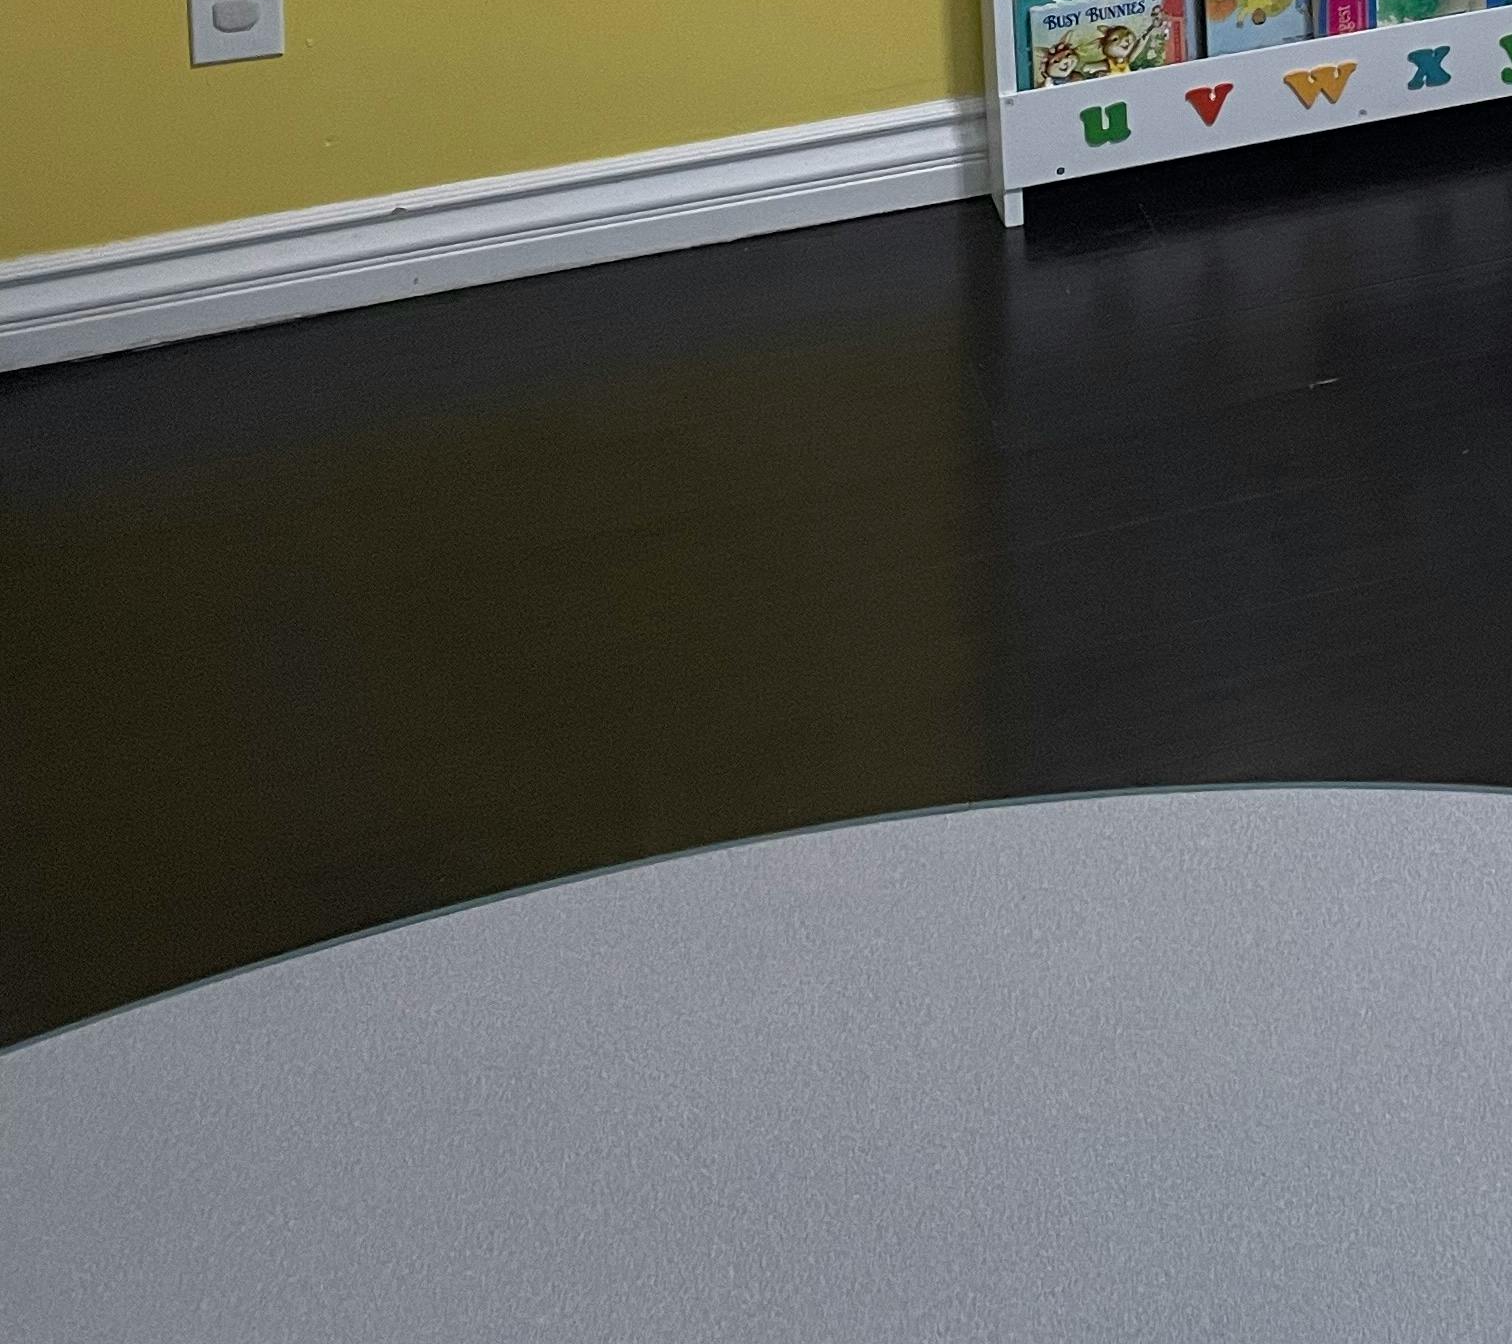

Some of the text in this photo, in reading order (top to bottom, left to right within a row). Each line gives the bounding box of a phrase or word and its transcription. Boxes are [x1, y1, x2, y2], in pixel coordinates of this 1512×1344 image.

[1284, 60, 1358, 110] w
[1407, 45, 1452, 90] x
[1080, 101, 1131, 148] u
[1185, 83, 1234, 127] v
